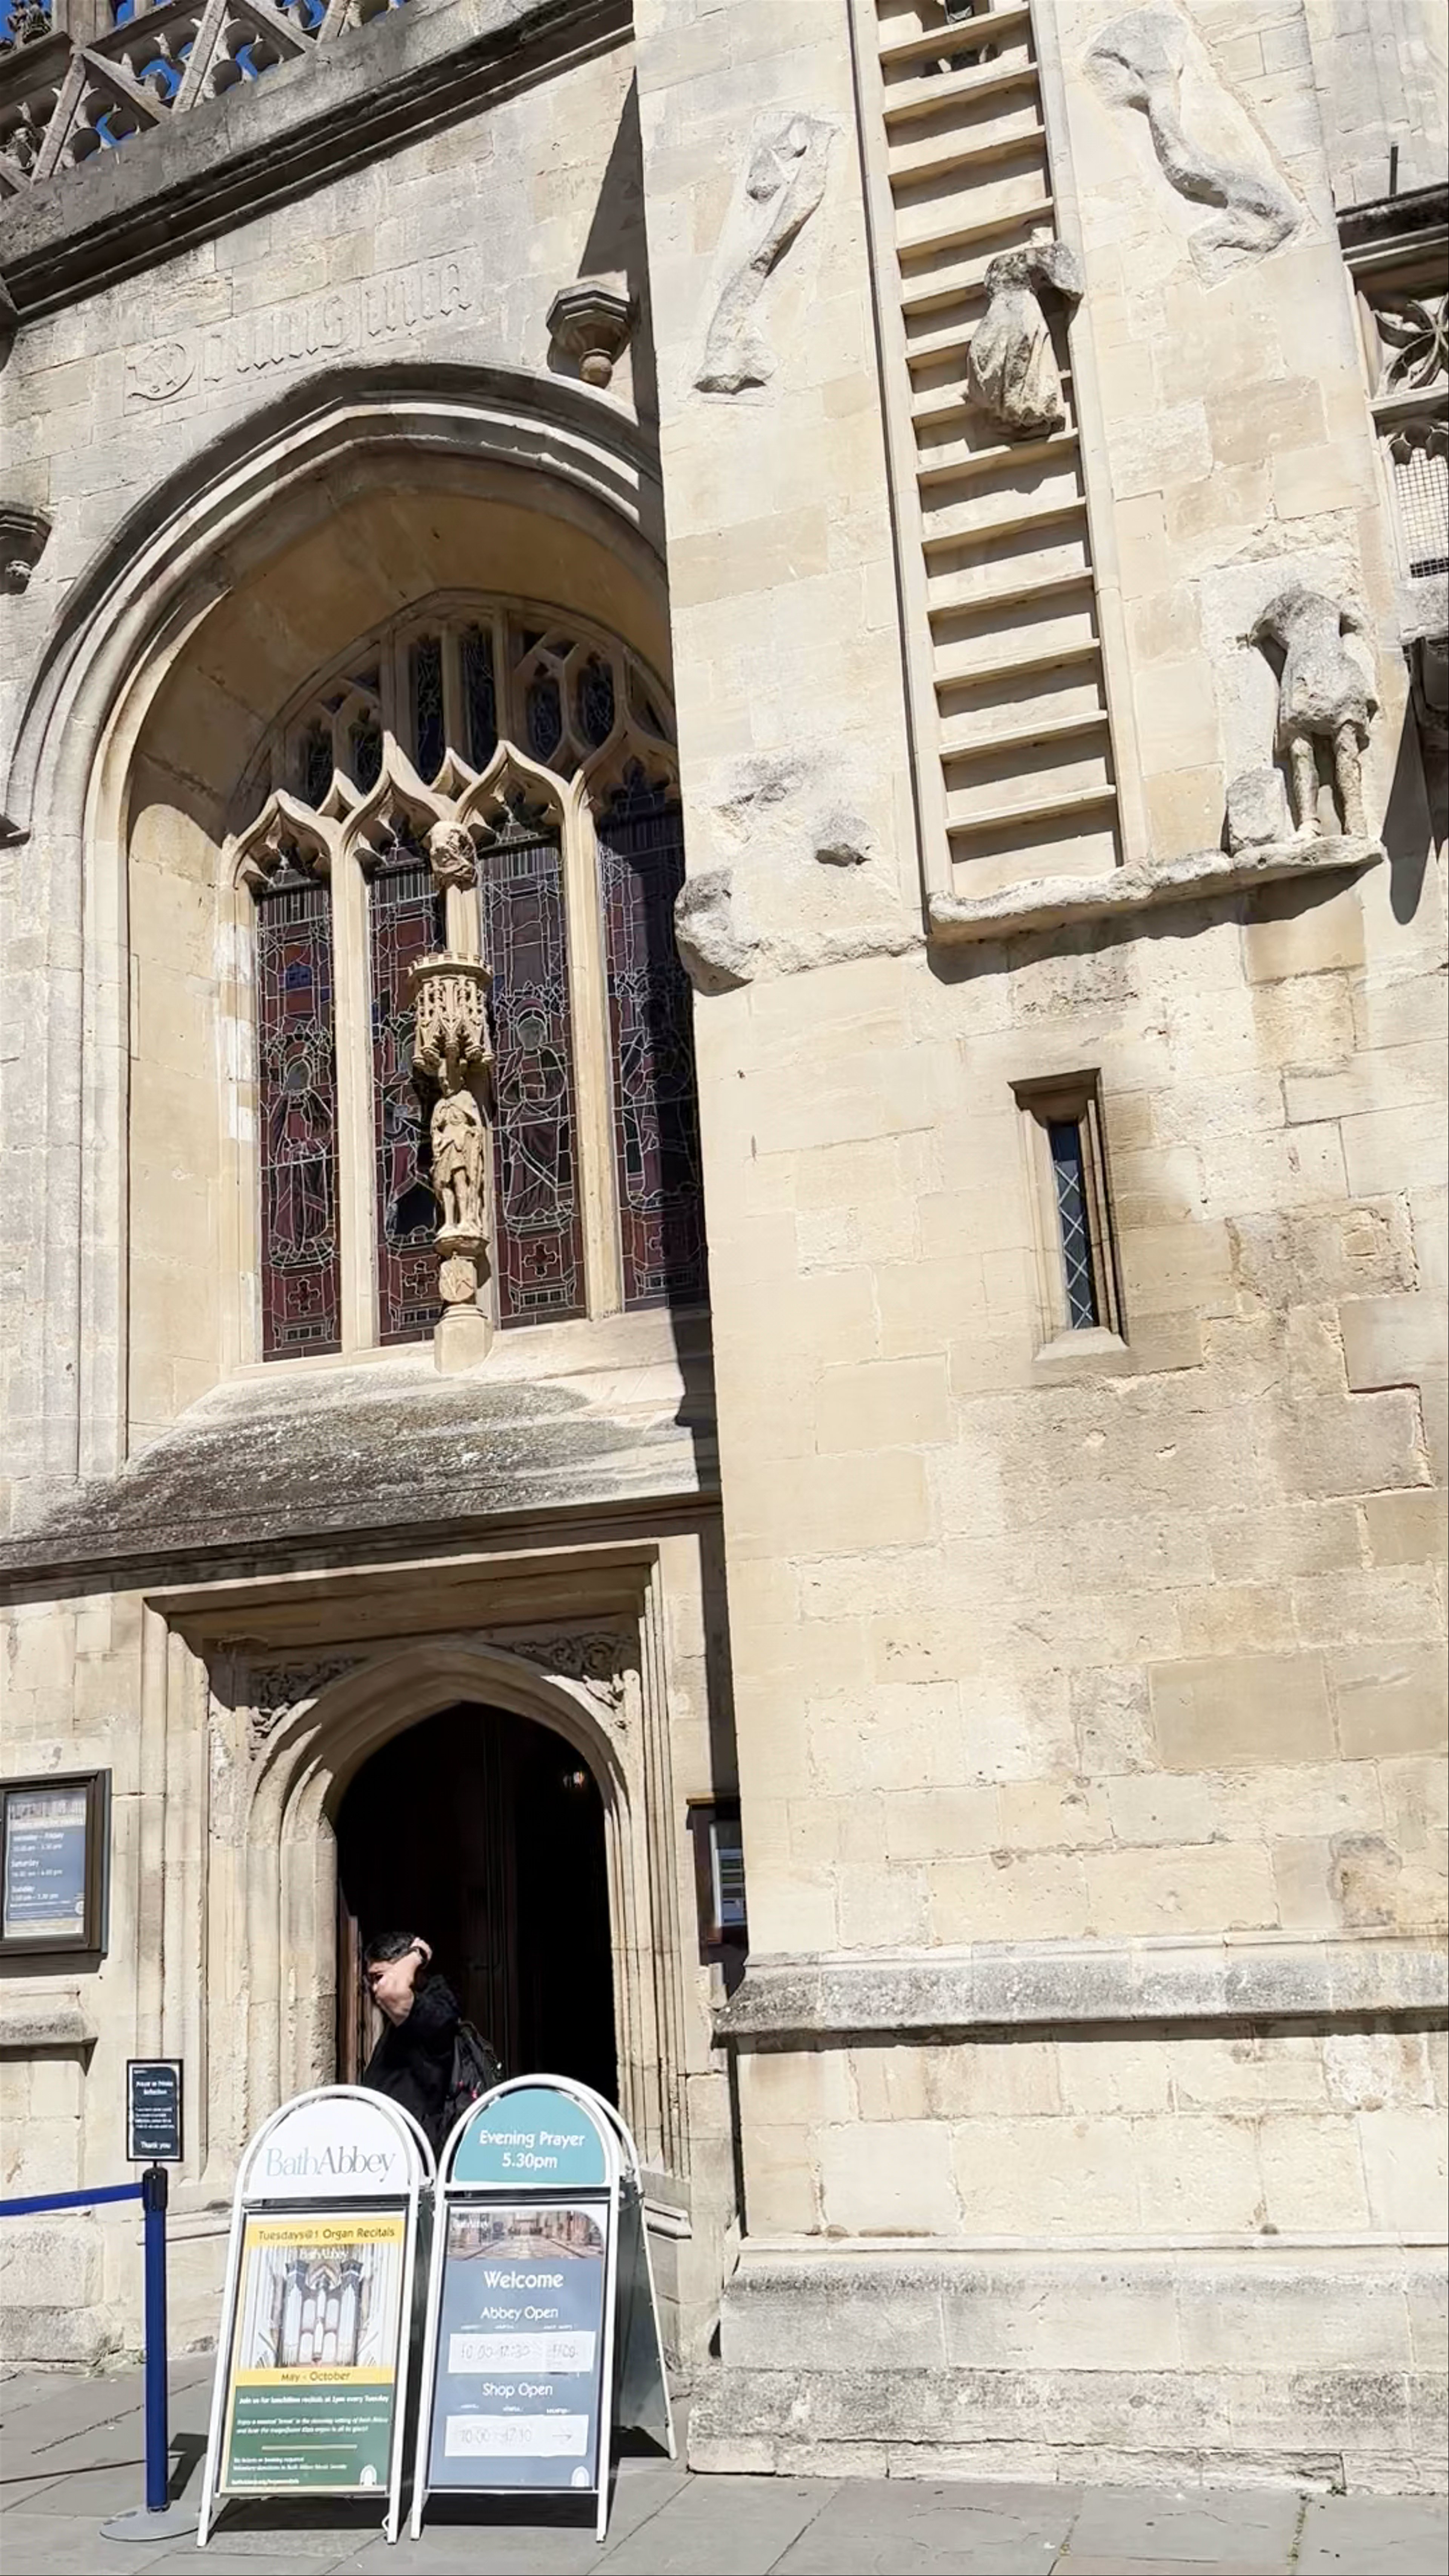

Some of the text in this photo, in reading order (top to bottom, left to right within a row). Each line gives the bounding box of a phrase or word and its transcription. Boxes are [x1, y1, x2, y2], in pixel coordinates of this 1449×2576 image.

[140, 2141, 158, 2149] Thank
[480, 2130, 585, 2149] Evening Prayer
[502, 2152, 558, 2172] 5.30pm
[323, 2228, 354, 2241] Organ
[357, 2227, 395, 2238] Recitals
[483, 2270, 564, 2289] Welcome
[480, 2306, 558, 2321] Abbey Open
[280, 2373, 300, 2383] May
[309, 2371, 350, 2382] October
[482, 2382, 553, 2398] Shop Open
[239, 2396, 252, 2405] Join
[365, 2394, 389, 2403] Tuesday
